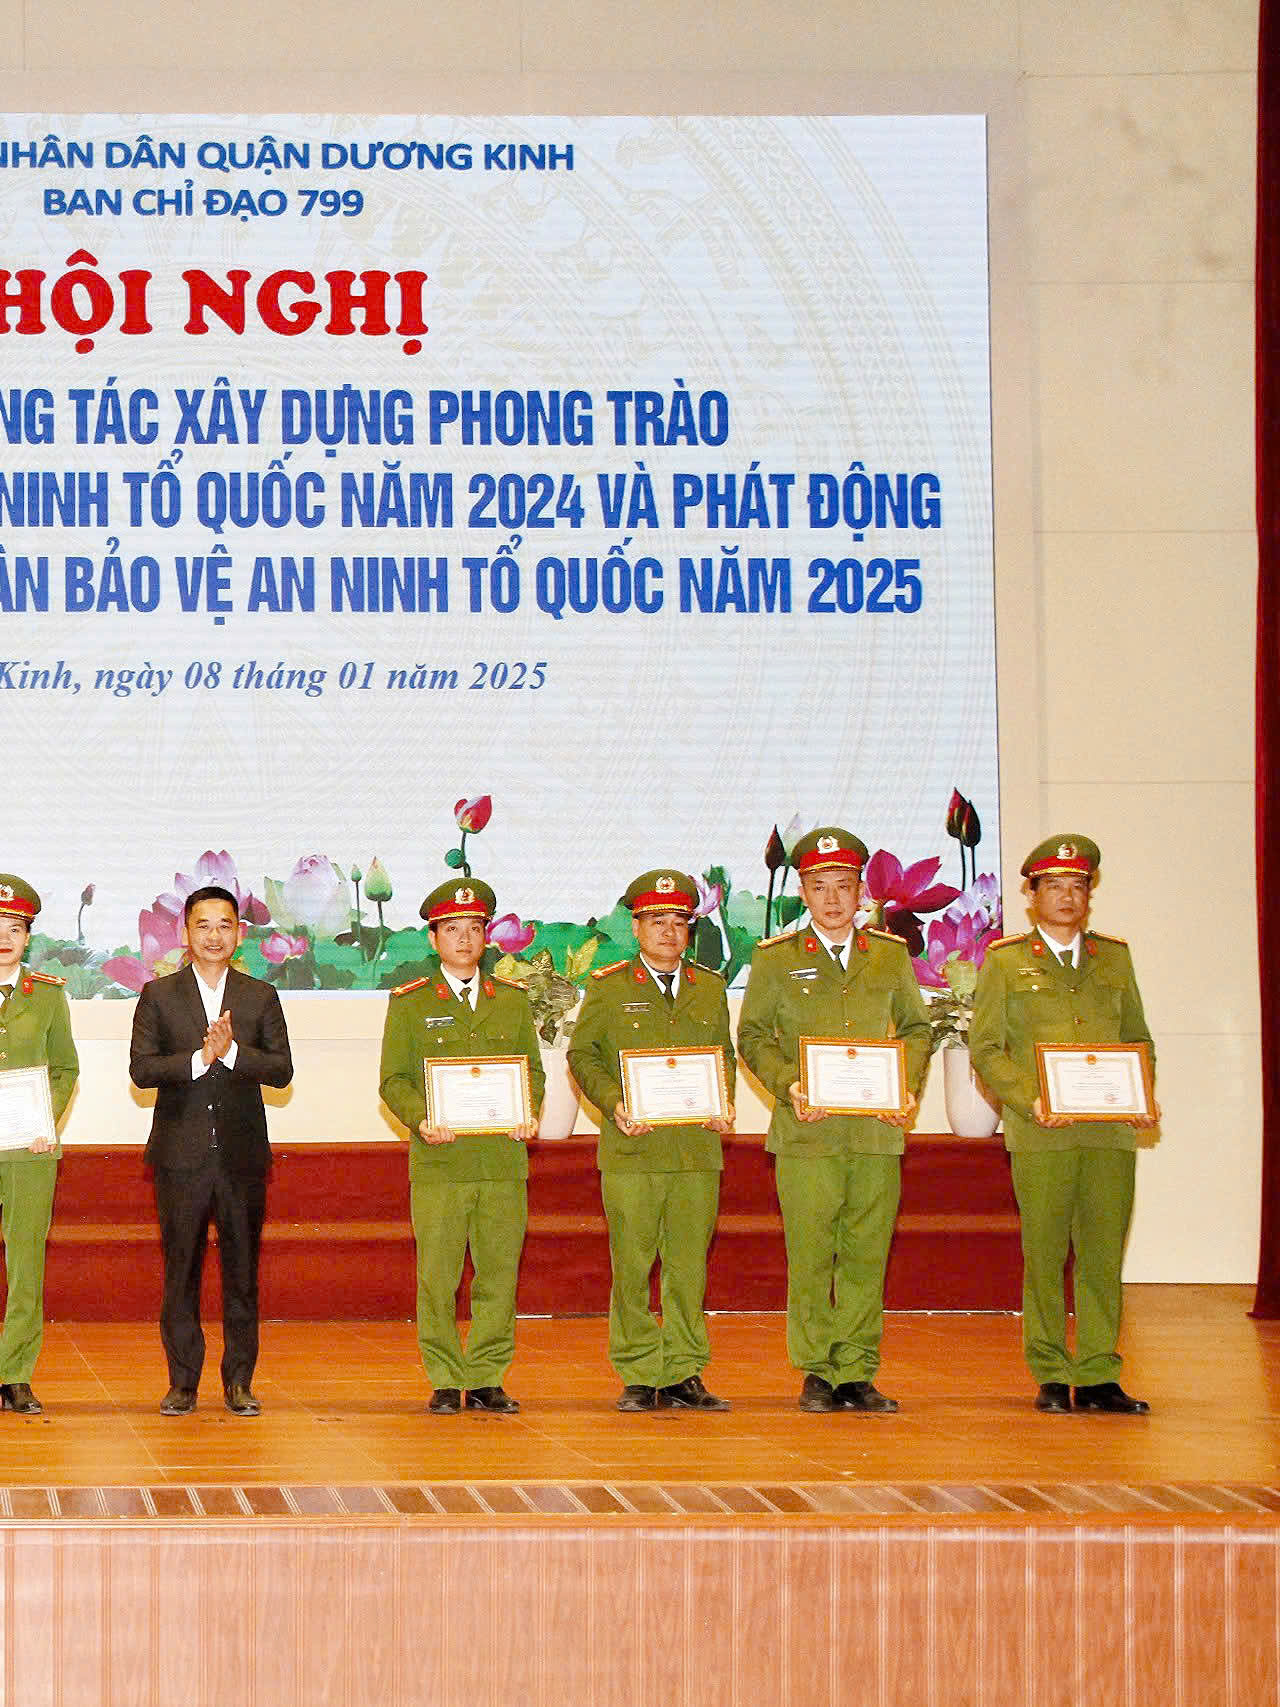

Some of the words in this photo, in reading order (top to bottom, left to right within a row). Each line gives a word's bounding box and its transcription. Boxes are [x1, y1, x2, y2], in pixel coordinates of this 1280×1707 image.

[105, 134, 186, 169] DÂN
[196, 135, 311, 177] QUẬN
[321, 141, 473, 171] DƯƠNG
[483, 143, 575, 171] KINH
[43, 188, 123, 216] BAN
[132, 178, 193, 217] CHỈ
[203, 188, 288, 222] ĐẠO
[298, 189, 365, 217] 799
[182, 268, 429, 356] NGHỊ
[68, 376, 160, 445] TÁC
[175, 376, 268, 445] XÂY
[281, 384, 414, 458] DỰNG
[428, 389, 594, 447] PHONG
[607, 377, 729, 447] TRÀO
[122, 448, 185, 529] TỔ
[196, 451, 326, 533] QUỐC
[340, 459, 454, 529] NĂM
[468, 472, 586, 530] 2024
[596, 459, 660, 530] VÀ
[672, 459, 796, 530] PHÁT
[807, 460, 943, 543] ĐỘNG
[65, 536, 161, 614] BẢO
[175, 543, 233, 625] VỆ
[247, 556, 316, 614] AN
[330, 556, 449, 614] NINH
[462, 533, 525, 614] TỔ
[535, 540, 665, 619] QUỐC
[679, 544, 793, 614] NĂM
[807, 557, 924, 614] 2025
[94, 661, 174, 698] ngày
[184, 661, 223, 690] 08
[231, 660, 327, 698] tháng
[337, 661, 376, 690] 01
[386, 664, 459, 690] năm
[468, 661, 549, 690] 2025
